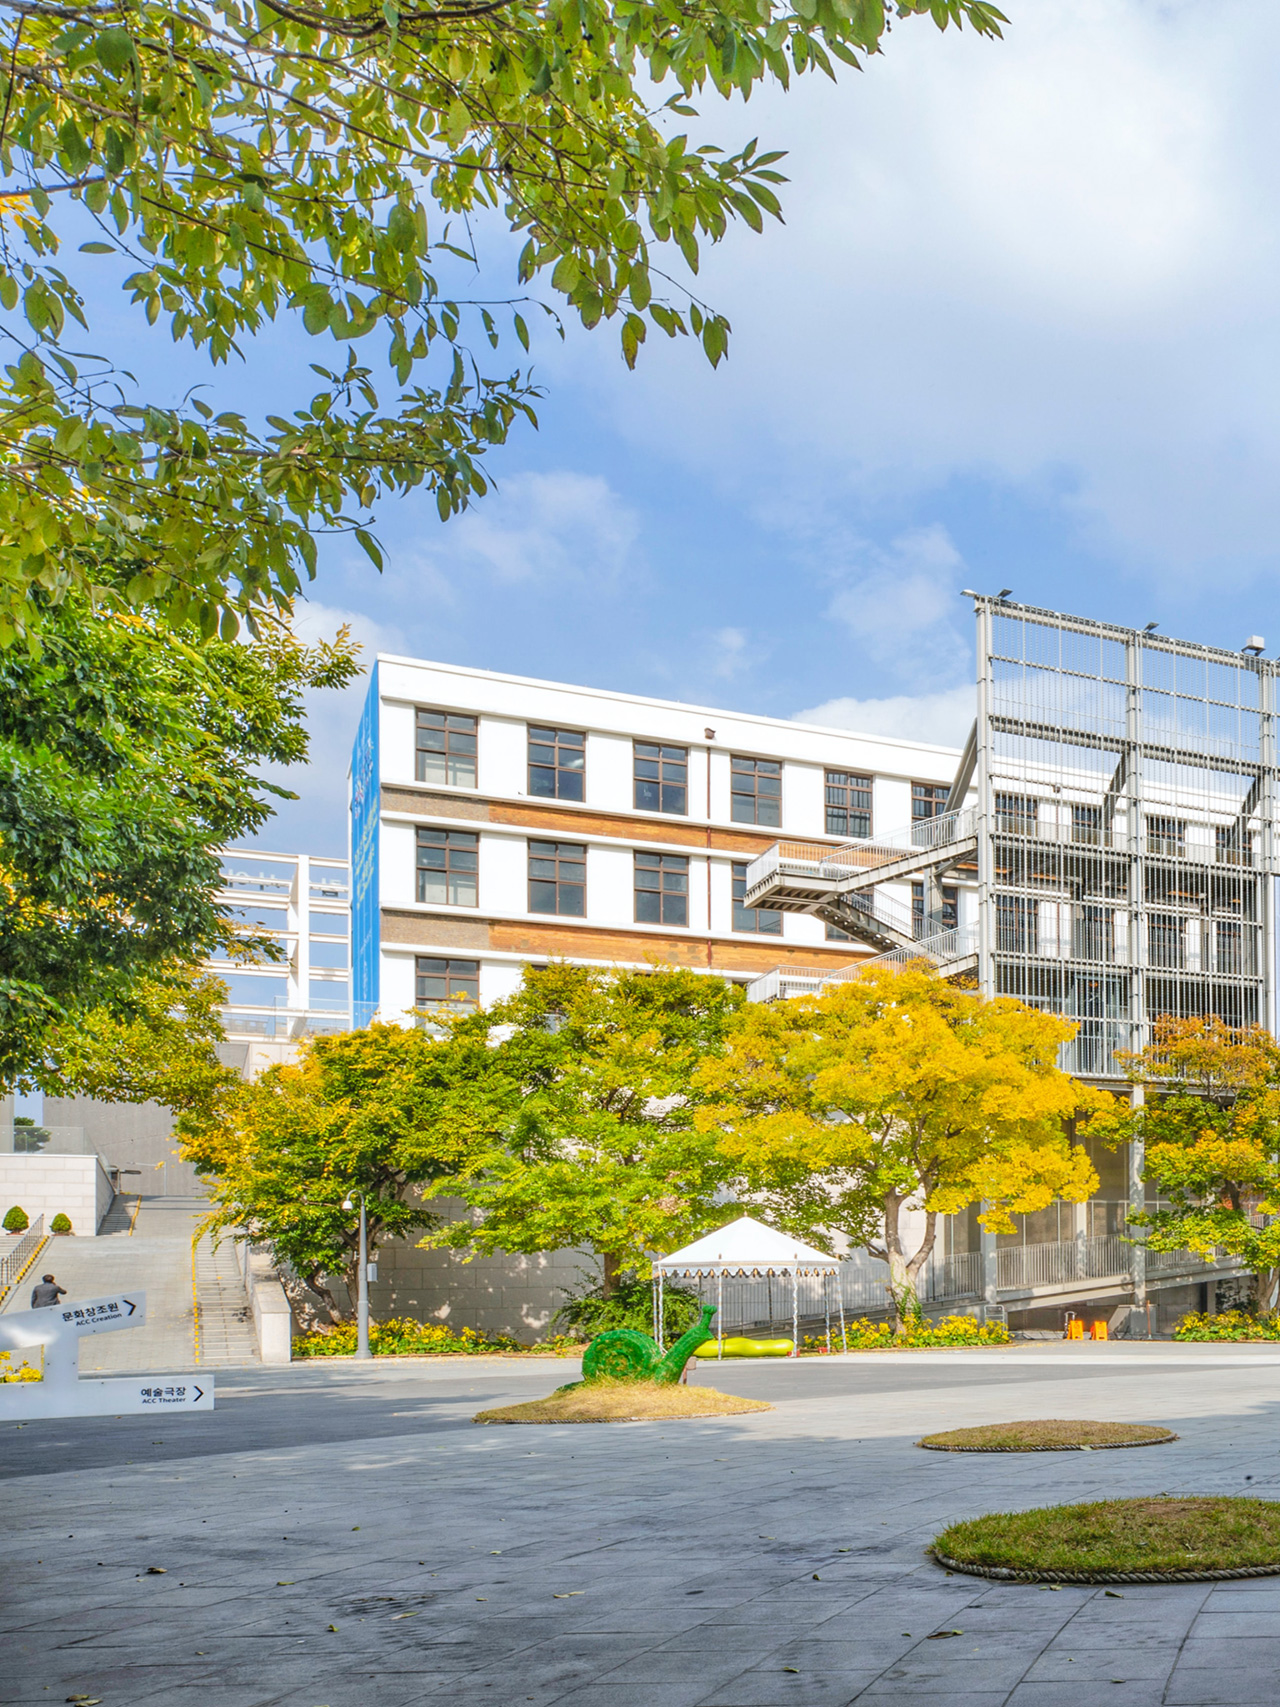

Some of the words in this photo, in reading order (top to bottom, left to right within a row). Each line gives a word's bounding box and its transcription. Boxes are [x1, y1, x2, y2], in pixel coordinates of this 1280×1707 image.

[62, 1302, 119, 1322] 문화창조원
[76, 1317, 91, 1326] ACC
[92, 1313, 122, 1324] Creation
[141, 1386, 186, 1397] 예술극장
[159, 1396, 186, 1404] Theater
